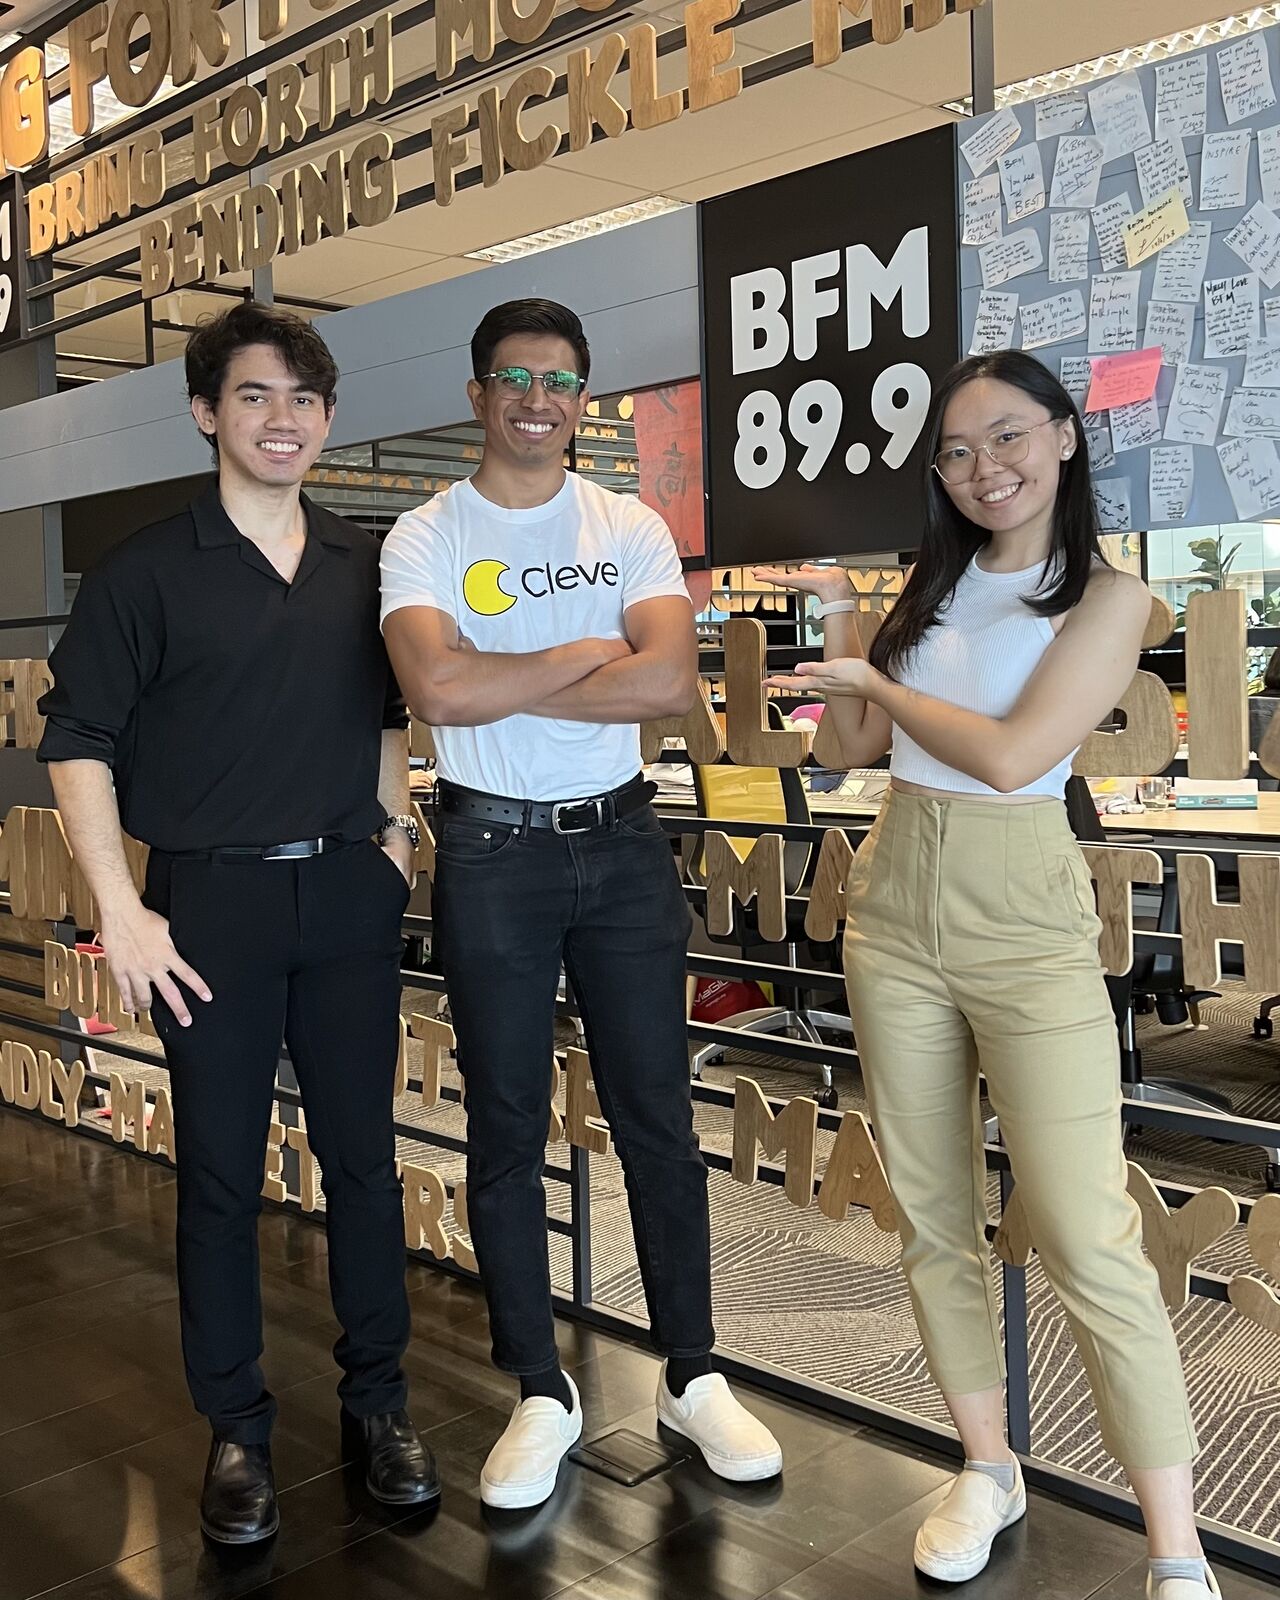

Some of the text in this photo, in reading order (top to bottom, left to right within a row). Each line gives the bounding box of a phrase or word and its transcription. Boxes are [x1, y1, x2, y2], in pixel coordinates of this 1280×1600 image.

[28, 128, 166, 257] BRING
[193, 11, 394, 184] FORTH
[140, 0, 744, 300] BENDING FICKLE
[731, 226, 930, 375] BFM
[734, 362, 932, 490] 89.9
[521, 561, 619, 598] Cleve
